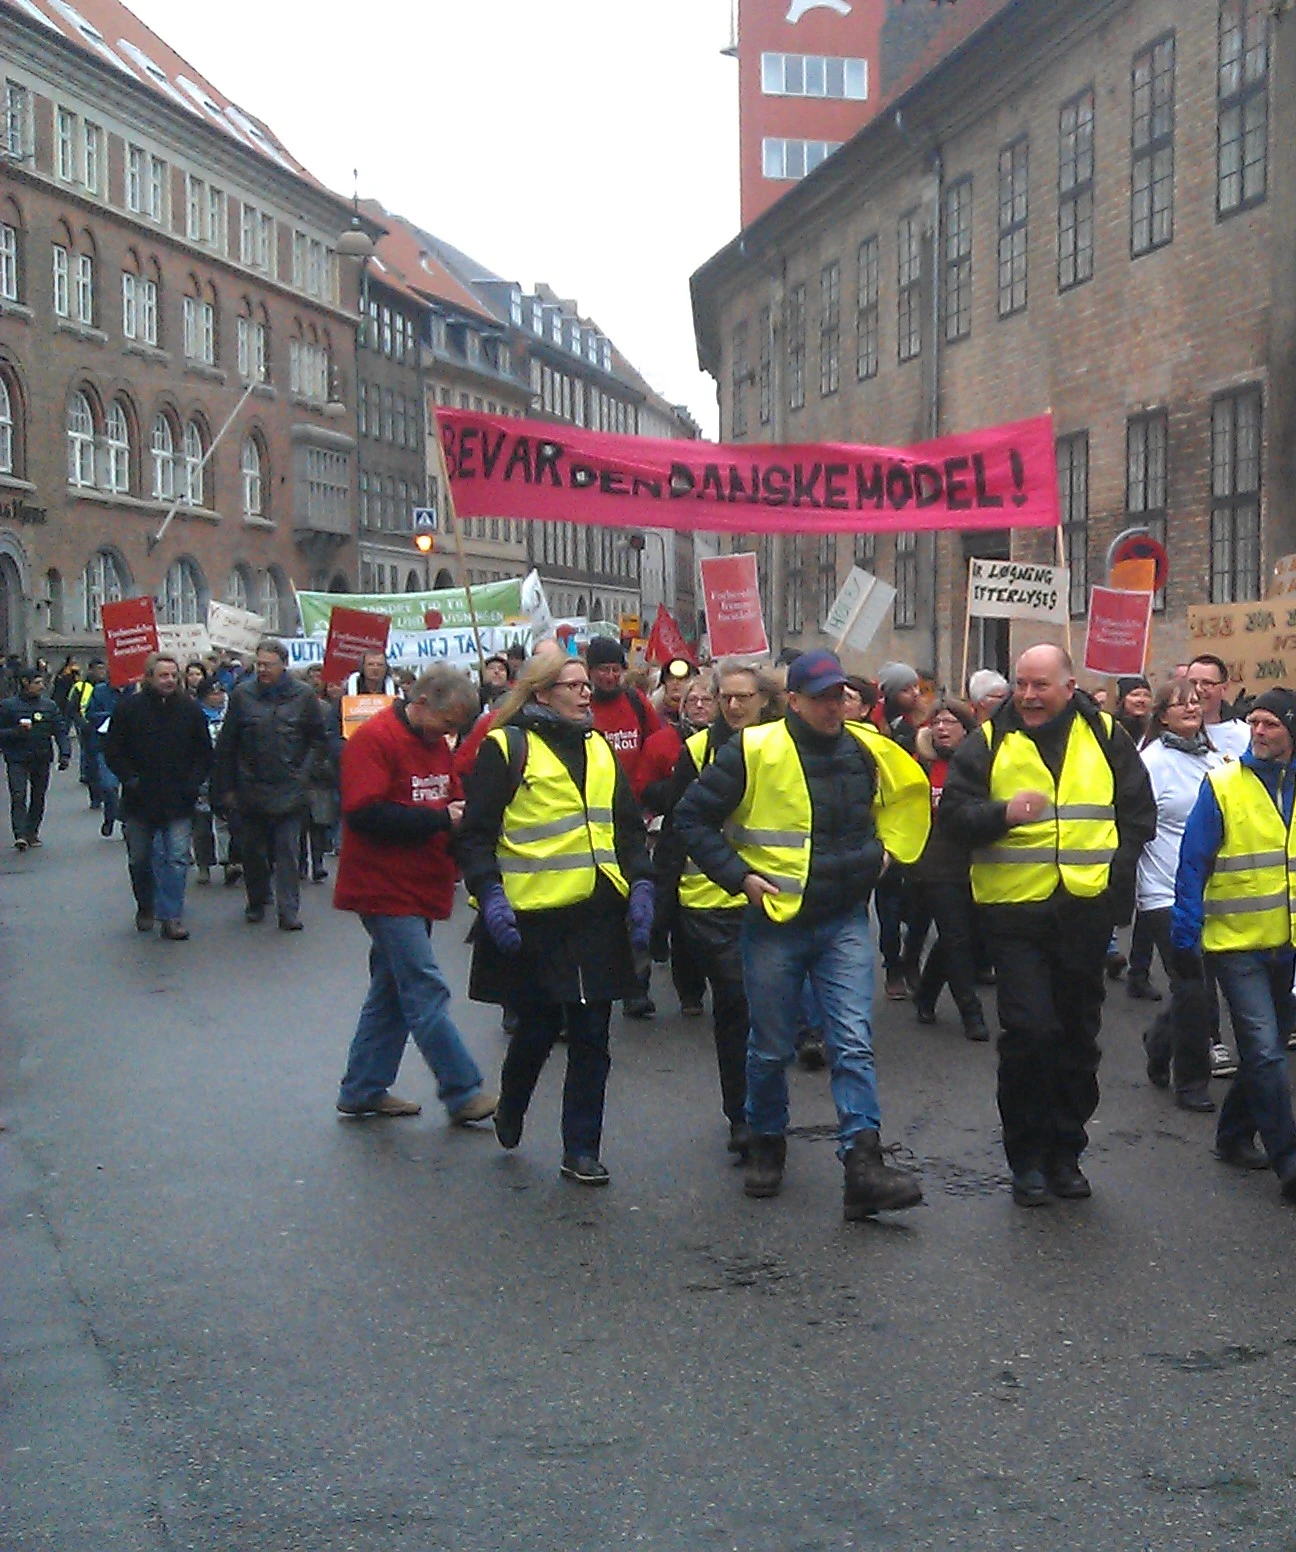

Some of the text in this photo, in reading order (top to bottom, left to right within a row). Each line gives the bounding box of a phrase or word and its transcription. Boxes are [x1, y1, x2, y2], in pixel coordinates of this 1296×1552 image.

[443, 423, 563, 487] BEVAR
[570, 464, 663, 499] DEN
[669, 461, 850, 508] DANSKE
[417, 637, 448, 658] NEJ
[453, 632, 491, 654] TAK
